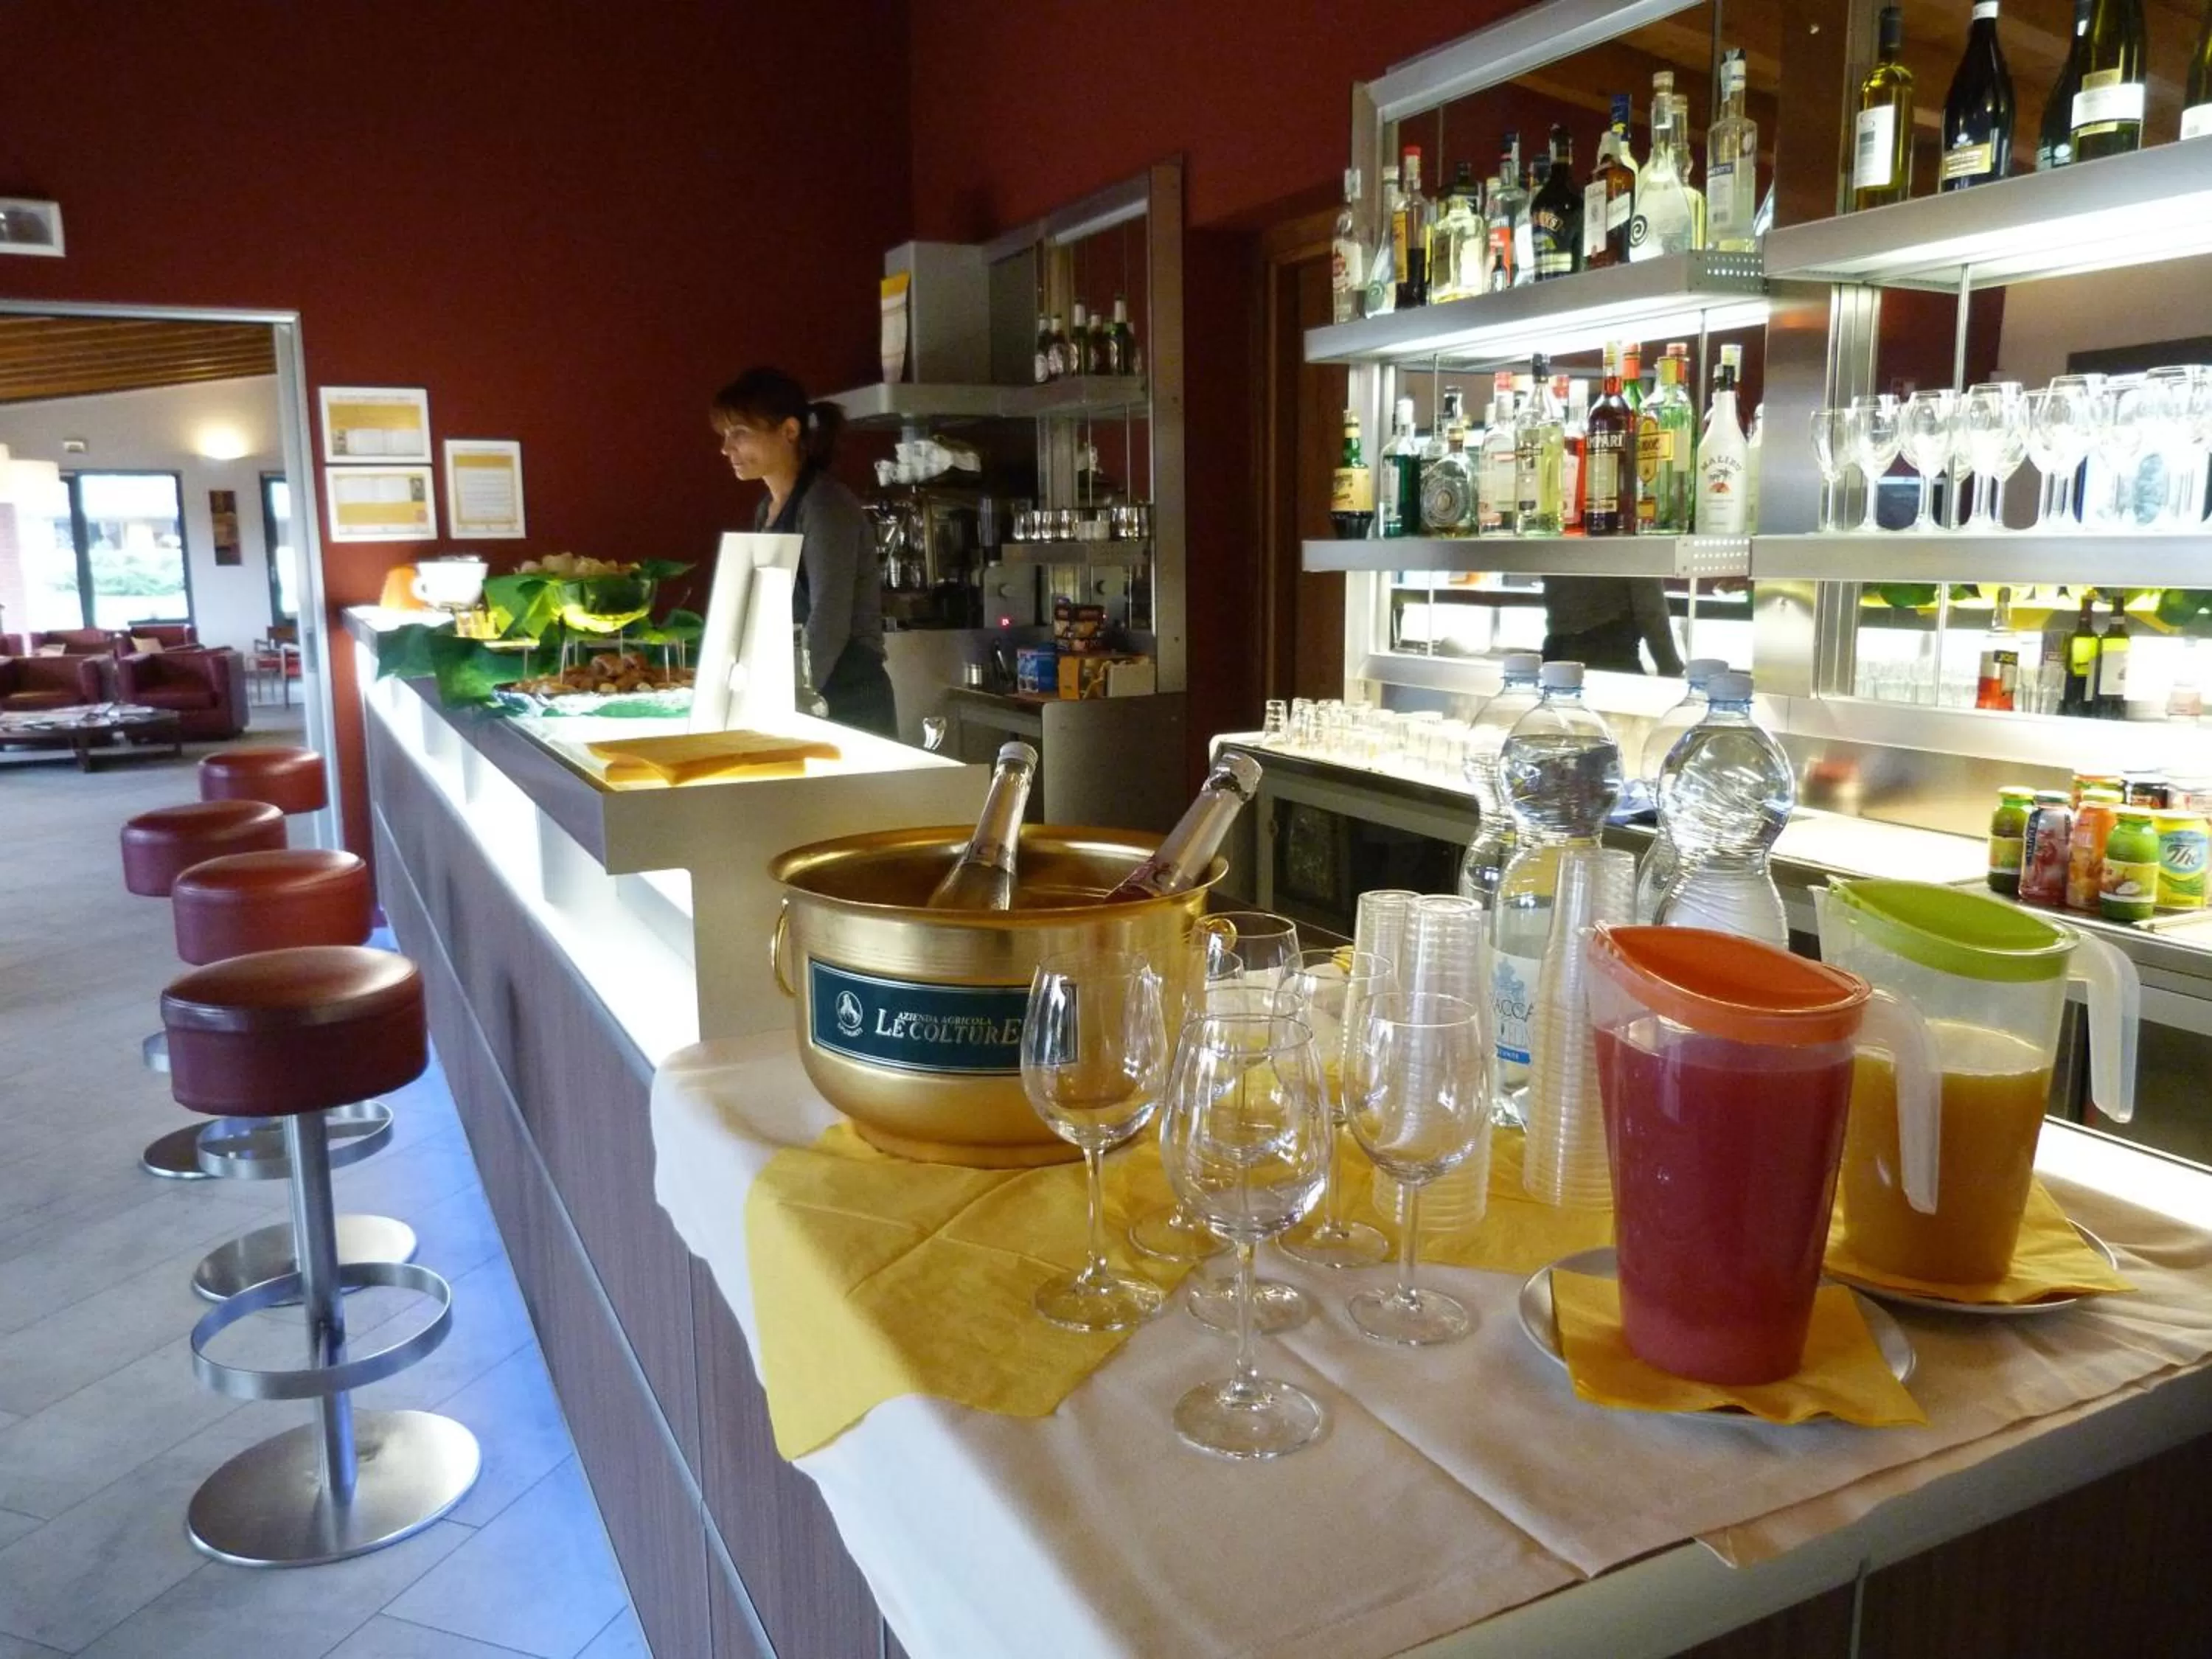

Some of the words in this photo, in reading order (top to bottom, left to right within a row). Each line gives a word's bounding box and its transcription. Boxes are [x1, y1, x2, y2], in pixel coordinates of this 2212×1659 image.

[1700, 453, 1743, 472] MALIBU
[897, 1011, 939, 1024] AZIENDA
[908, 1018, 1022, 1045] COLTURE
